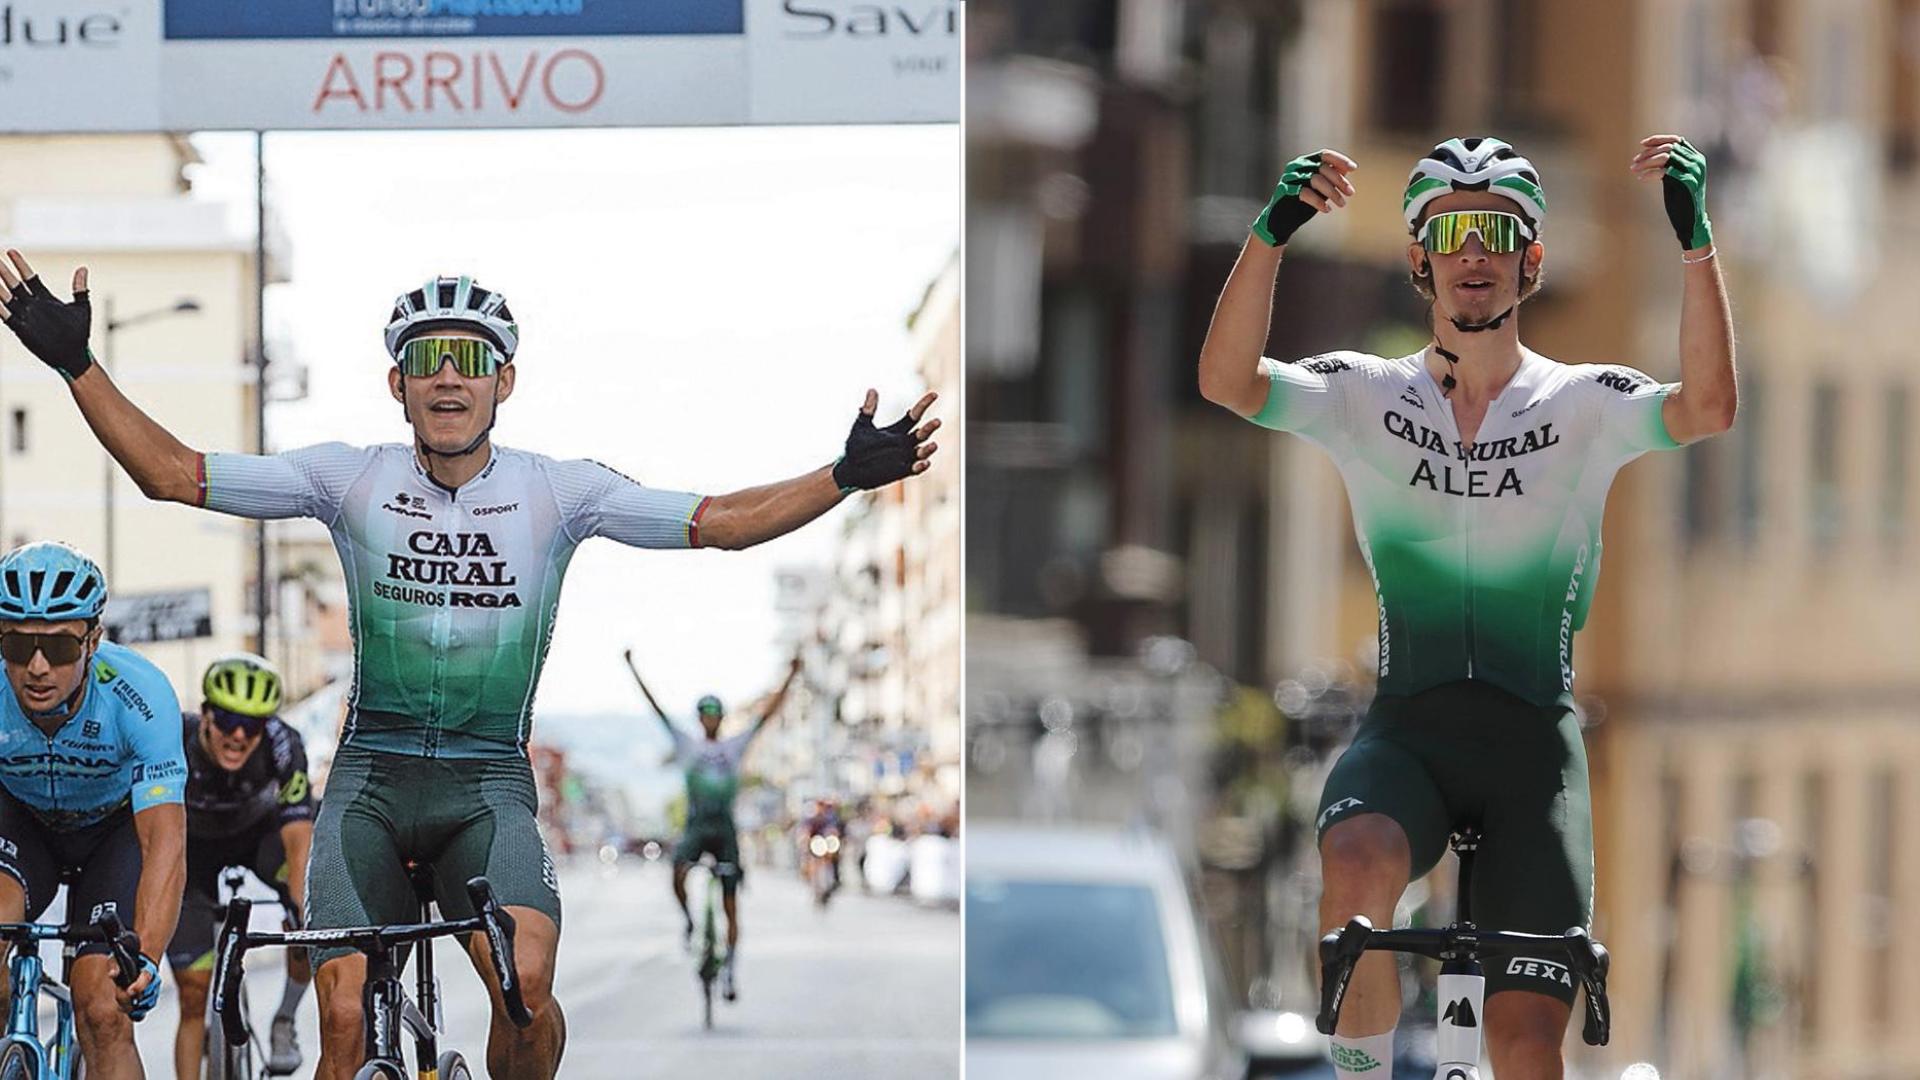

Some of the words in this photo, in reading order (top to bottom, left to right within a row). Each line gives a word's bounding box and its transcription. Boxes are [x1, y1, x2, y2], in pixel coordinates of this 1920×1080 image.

[314, 49, 604, 113] ARRIVO
[1384, 410, 1449, 456] CAJA
[1453, 423, 1559, 461] RURAL
[1409, 458, 1524, 498] ALEA
[408, 531, 498, 557] CAJA
[386, 553, 516, 587] RURAL
[1565, 543, 1588, 602] CAJA
[373, 581, 446, 607] SEGUROS
[449, 591, 522, 608] RGA
[116, 678, 154, 722] FREEDOM
[1506, 956, 1572, 988] GEXA
